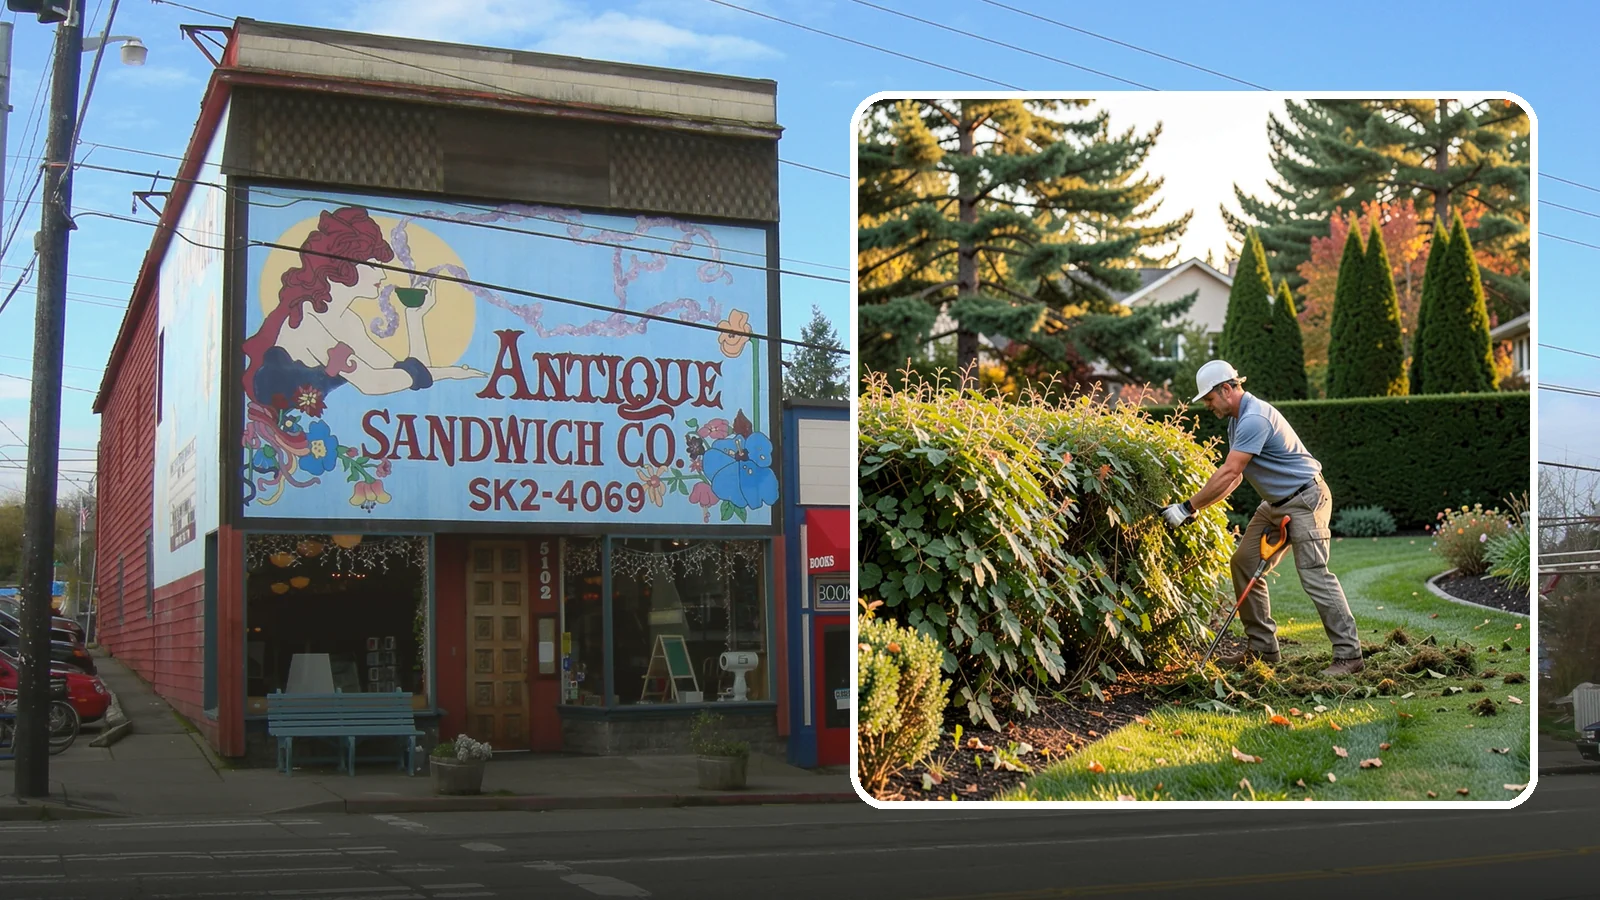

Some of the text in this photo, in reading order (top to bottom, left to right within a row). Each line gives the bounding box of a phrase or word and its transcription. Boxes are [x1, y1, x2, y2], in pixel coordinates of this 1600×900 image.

[476, 329, 724, 421] ANTIQUE
[361, 408, 685, 469] SANDWICH CO.
[468, 477, 646, 513] SK2-4069
[539, 542, 551, 599] 5102
[809, 555, 834, 568] BOOKS
